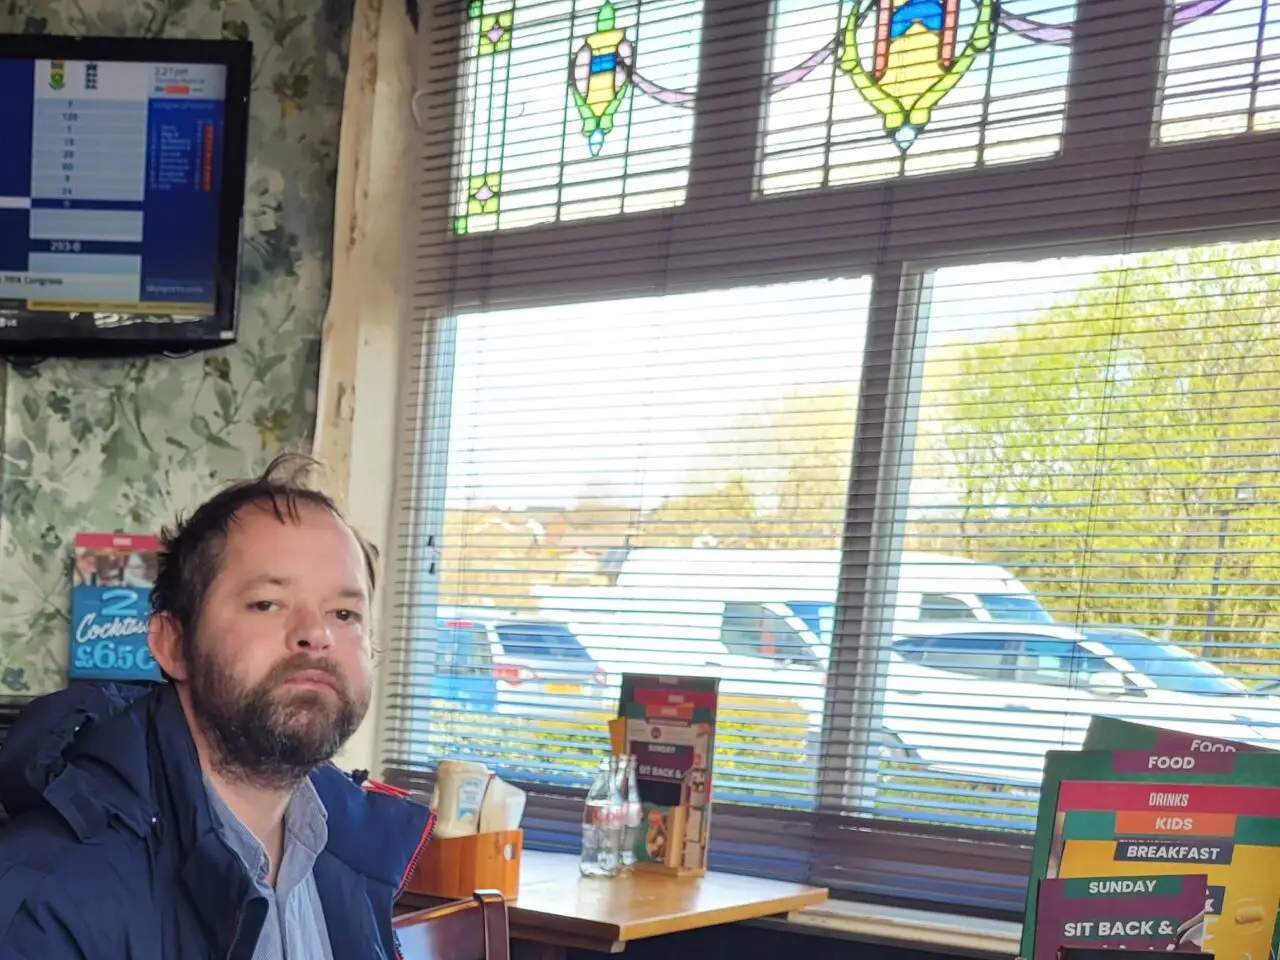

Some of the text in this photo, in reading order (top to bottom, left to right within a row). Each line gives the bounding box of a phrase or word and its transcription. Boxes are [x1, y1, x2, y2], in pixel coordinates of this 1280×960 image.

[101, 588, 138, 616] 2
[1148, 756, 1195, 769] FOOD
[1148, 792, 1190, 807] DRINKS
[1155, 816, 1193, 831] KIDS
[1126, 845, 1221, 861] BREAKFAST
[1088, 880, 1157, 894] SUNDAY
[1063, 920, 1173, 937] SIT BACK &
